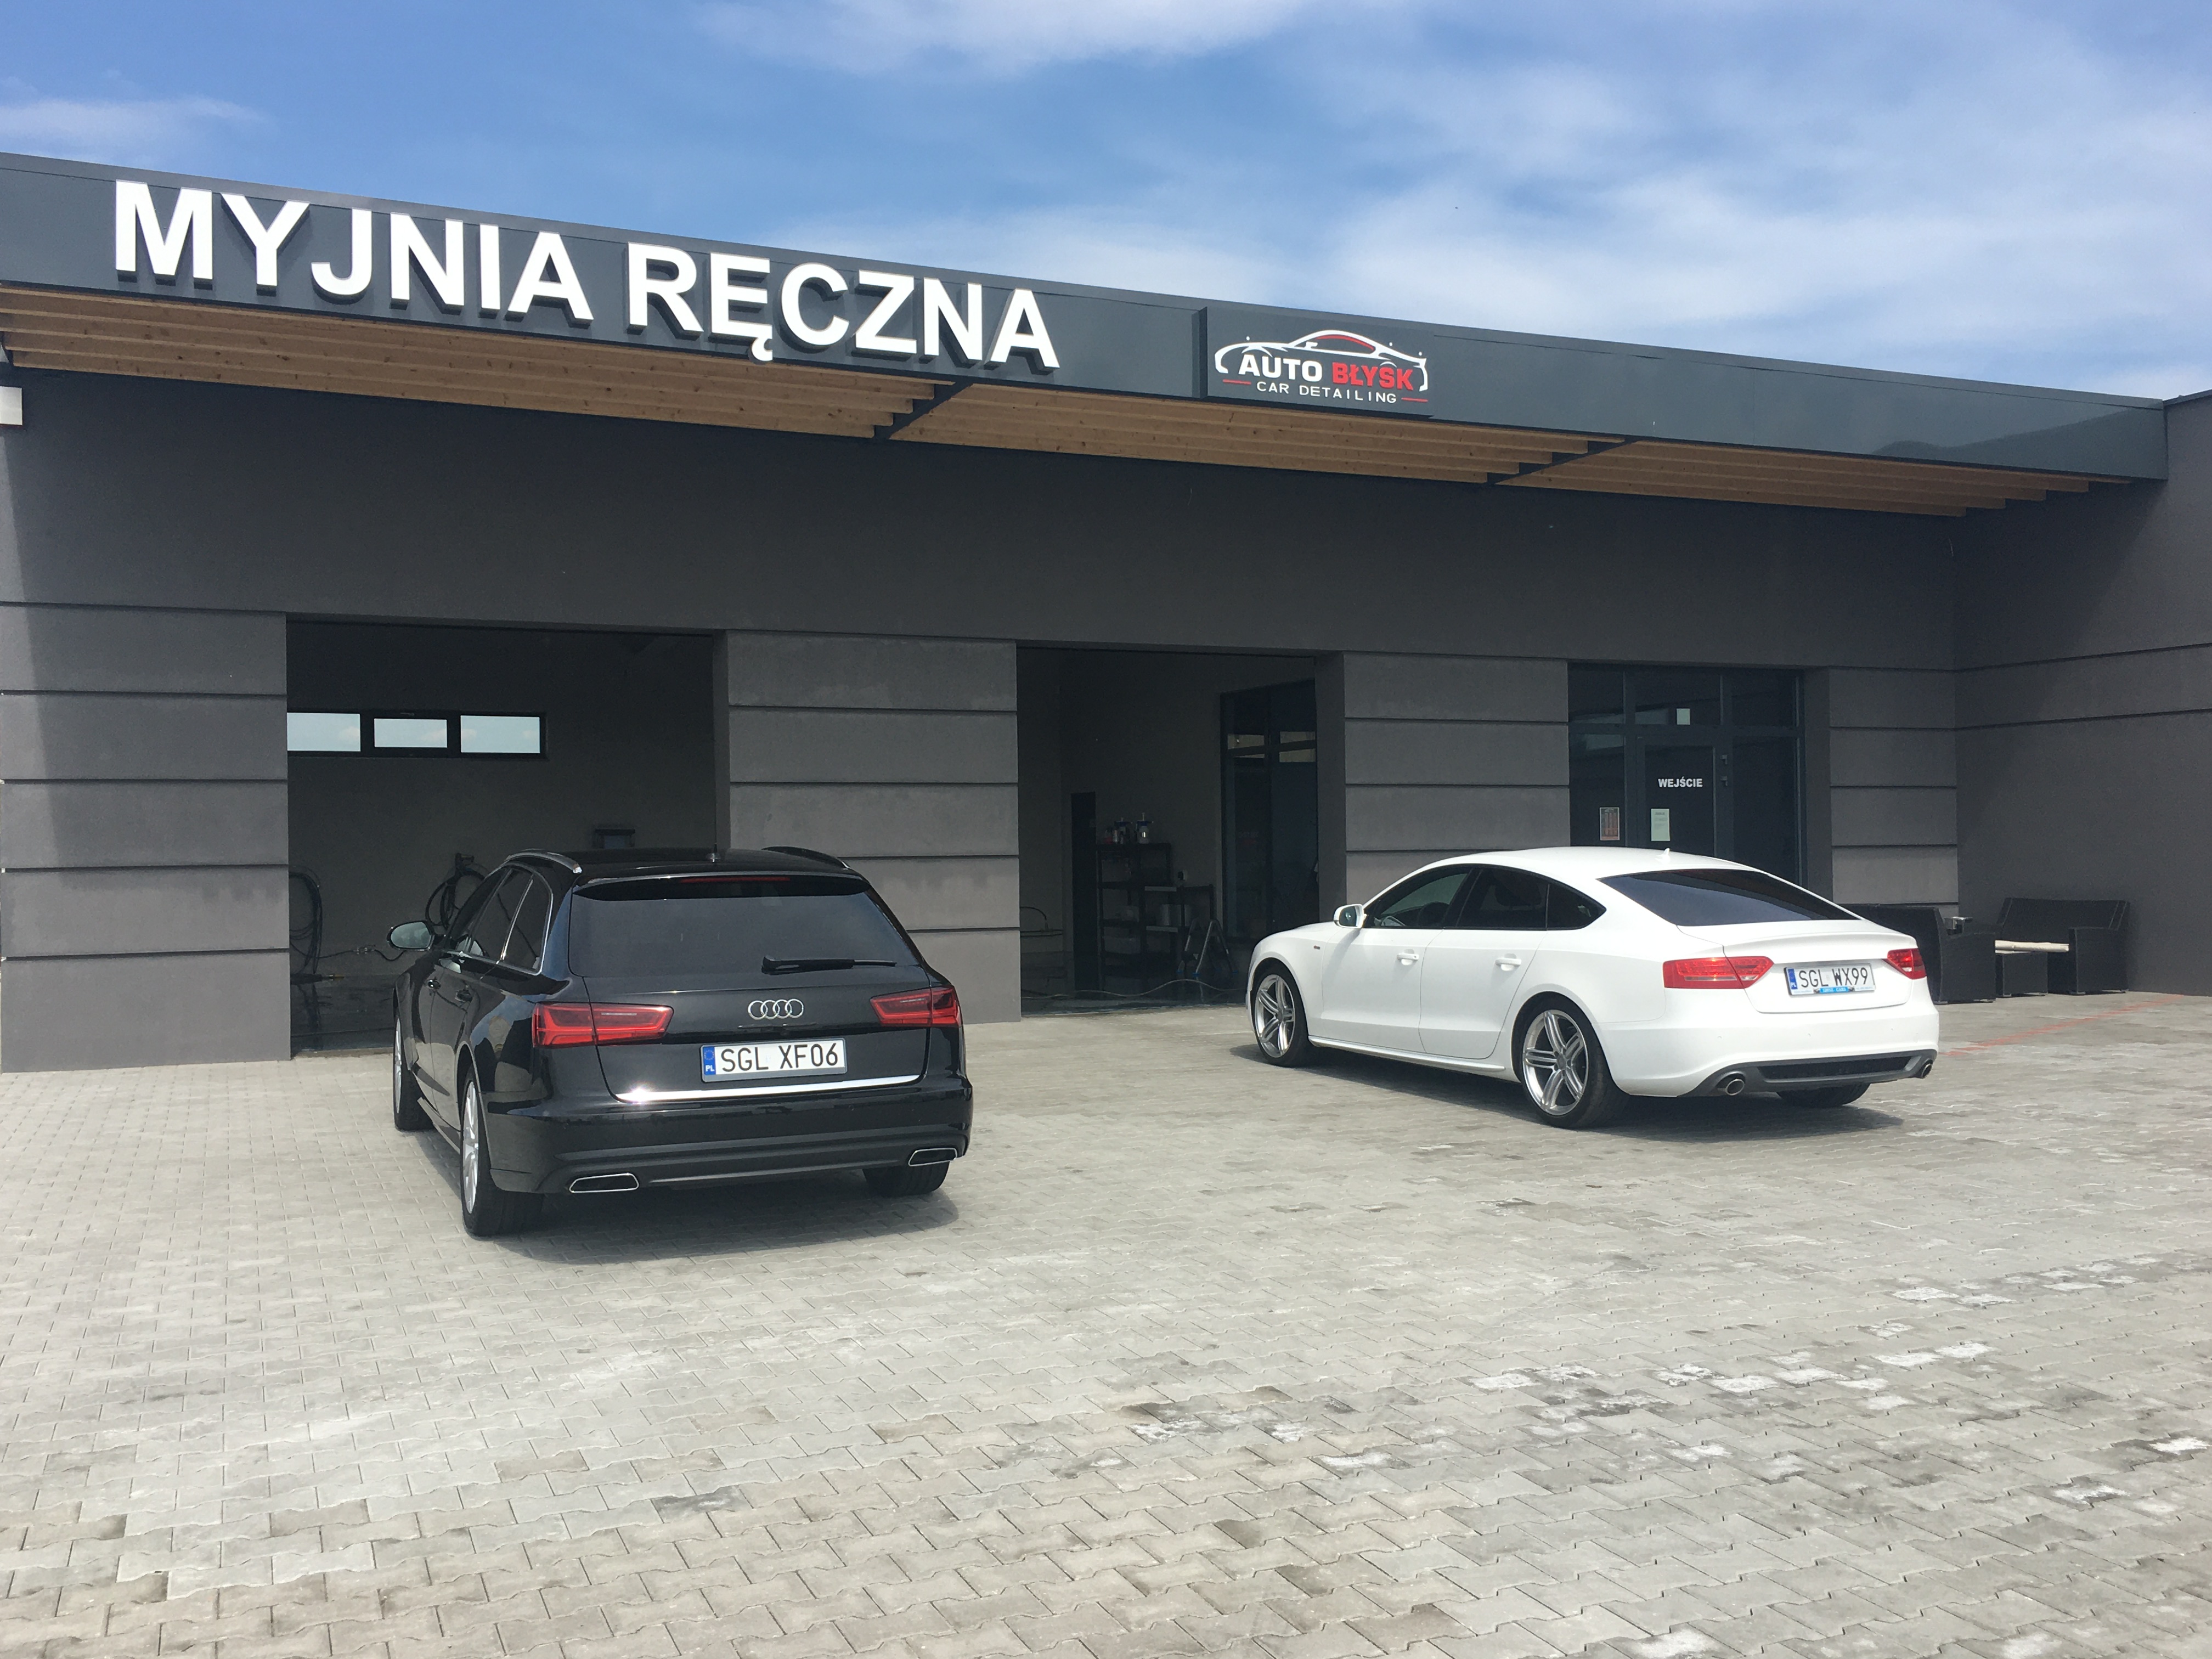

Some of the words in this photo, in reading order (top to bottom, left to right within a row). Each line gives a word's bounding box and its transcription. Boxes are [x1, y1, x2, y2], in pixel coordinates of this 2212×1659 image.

[115, 179, 594, 326] MYJNIA
[627, 240, 1061, 373] RĘCZNA
[1238, 354, 1323, 383] AUTO
[1331, 362, 1414, 391] BŁYSK
[1256, 381, 1289, 394] CAR
[1299, 385, 1397, 404] DETAILING
[1657, 776, 1703, 788] WEJŚCIE
[1798, 969, 1829, 988] SGL
[1831, 967, 1868, 986] WX99
[720, 1047, 769, 1073] SGL
[778, 1042, 838, 1069] XF06
